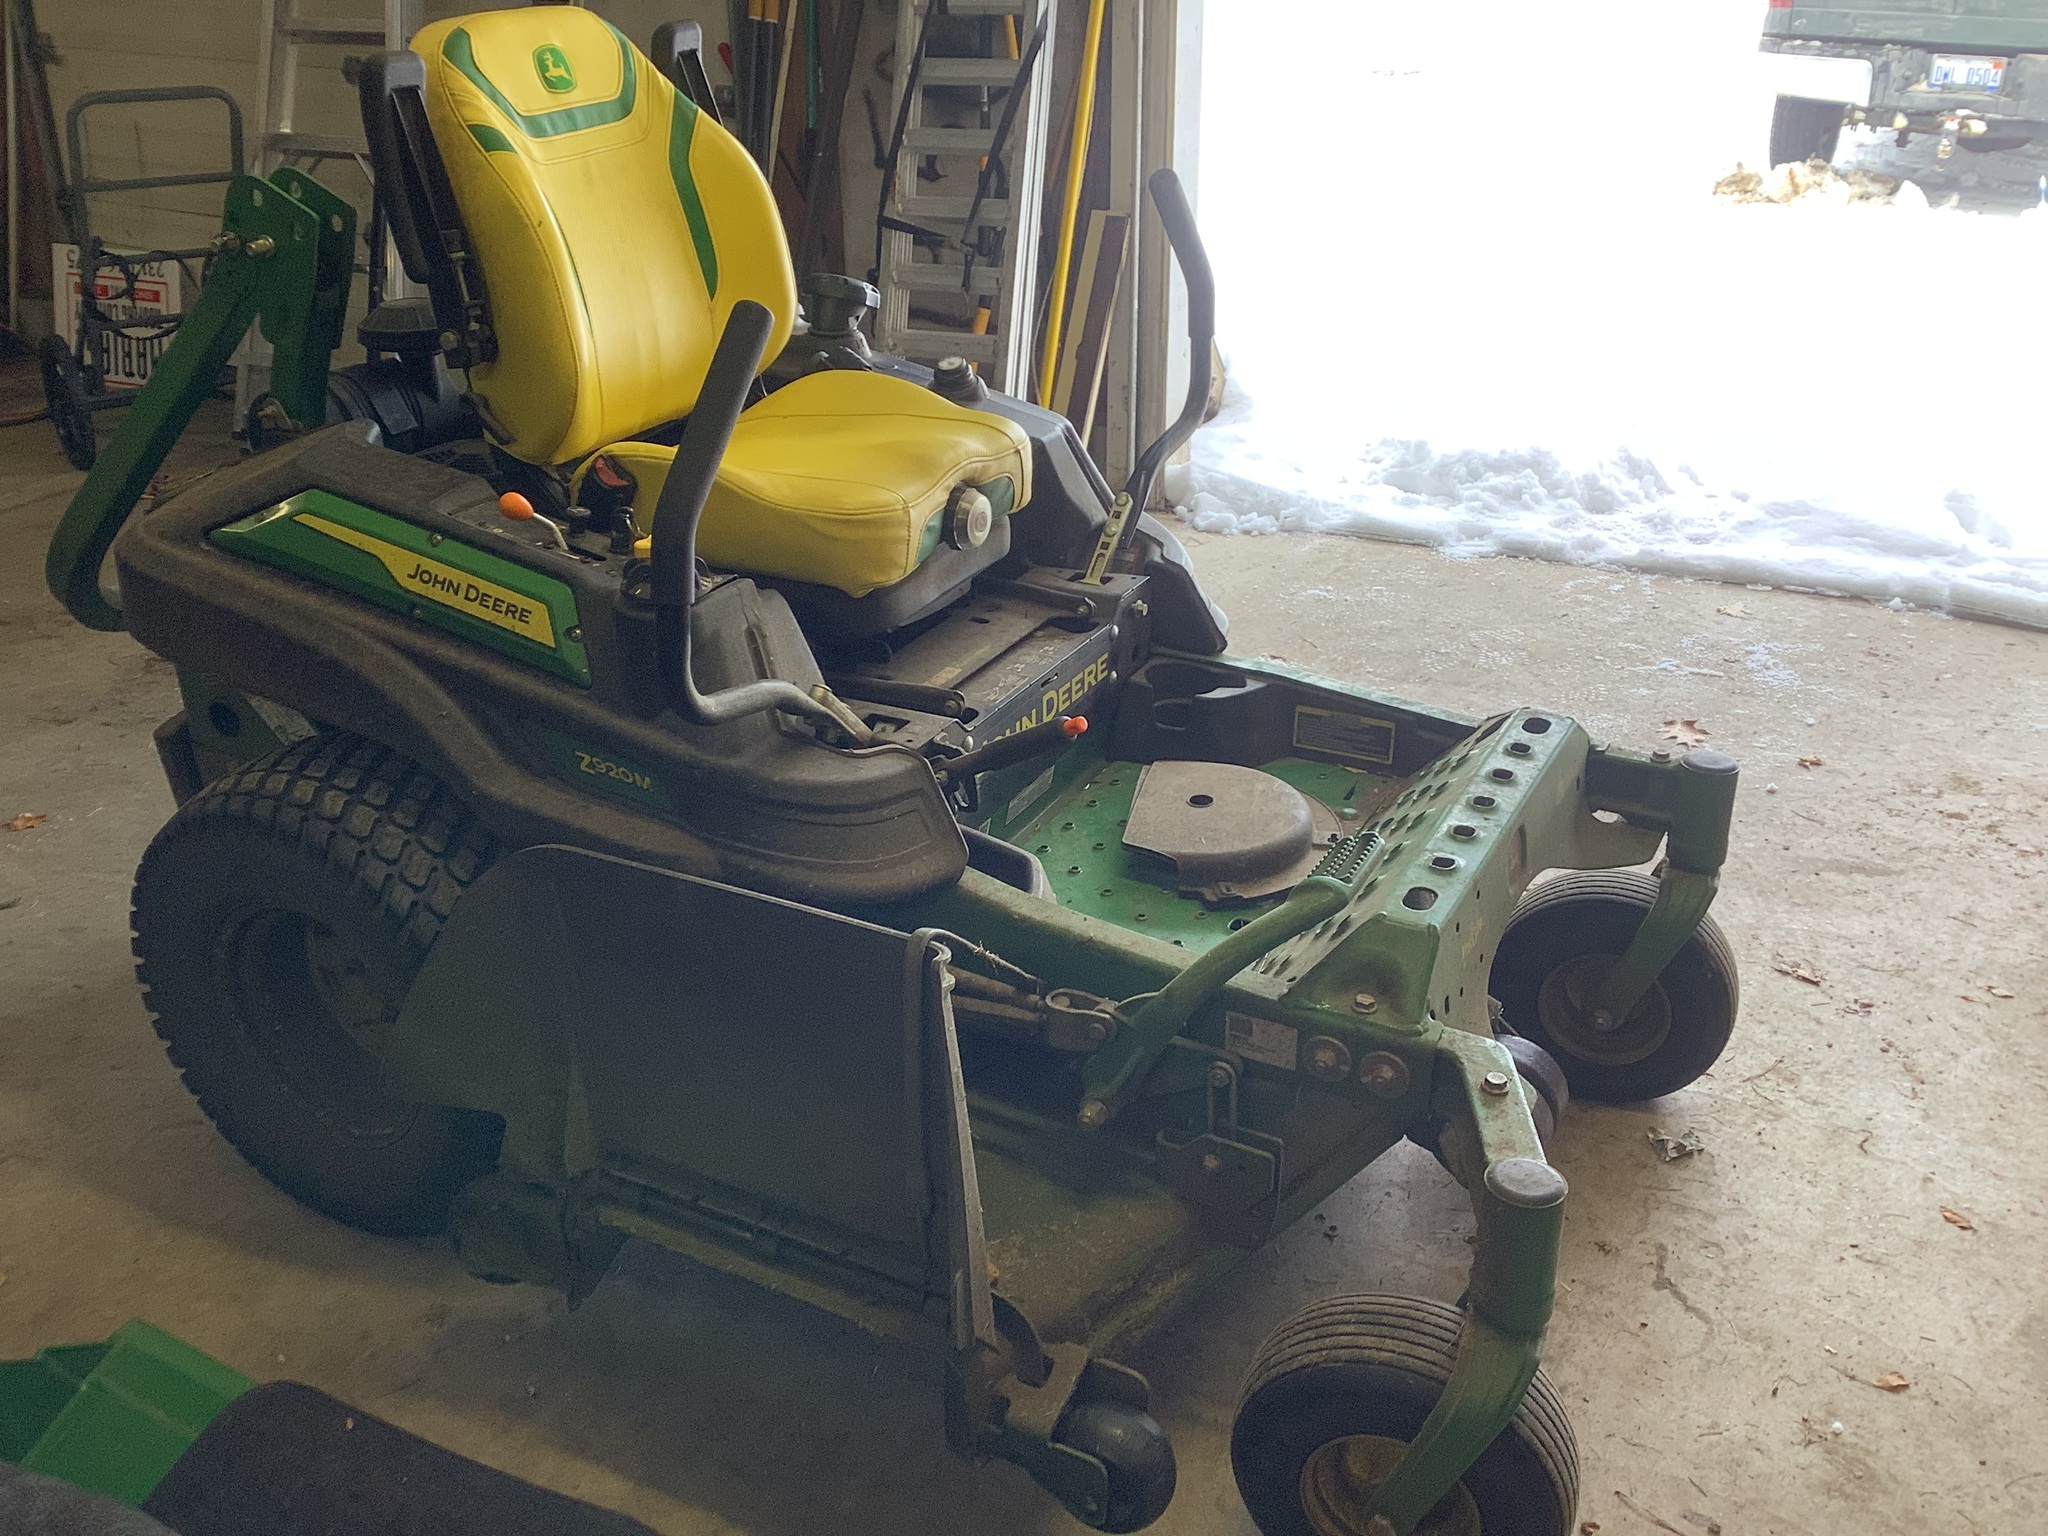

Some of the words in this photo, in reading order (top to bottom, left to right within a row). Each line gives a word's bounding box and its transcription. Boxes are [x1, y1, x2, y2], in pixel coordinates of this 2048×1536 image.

[1966, 67, 2000, 85] 0504
[406, 562, 461, 597] JOHN
[464, 583, 532, 625] DEERE
[1041, 652, 1109, 723] DEERE
[574, 750, 652, 790] Z920M
